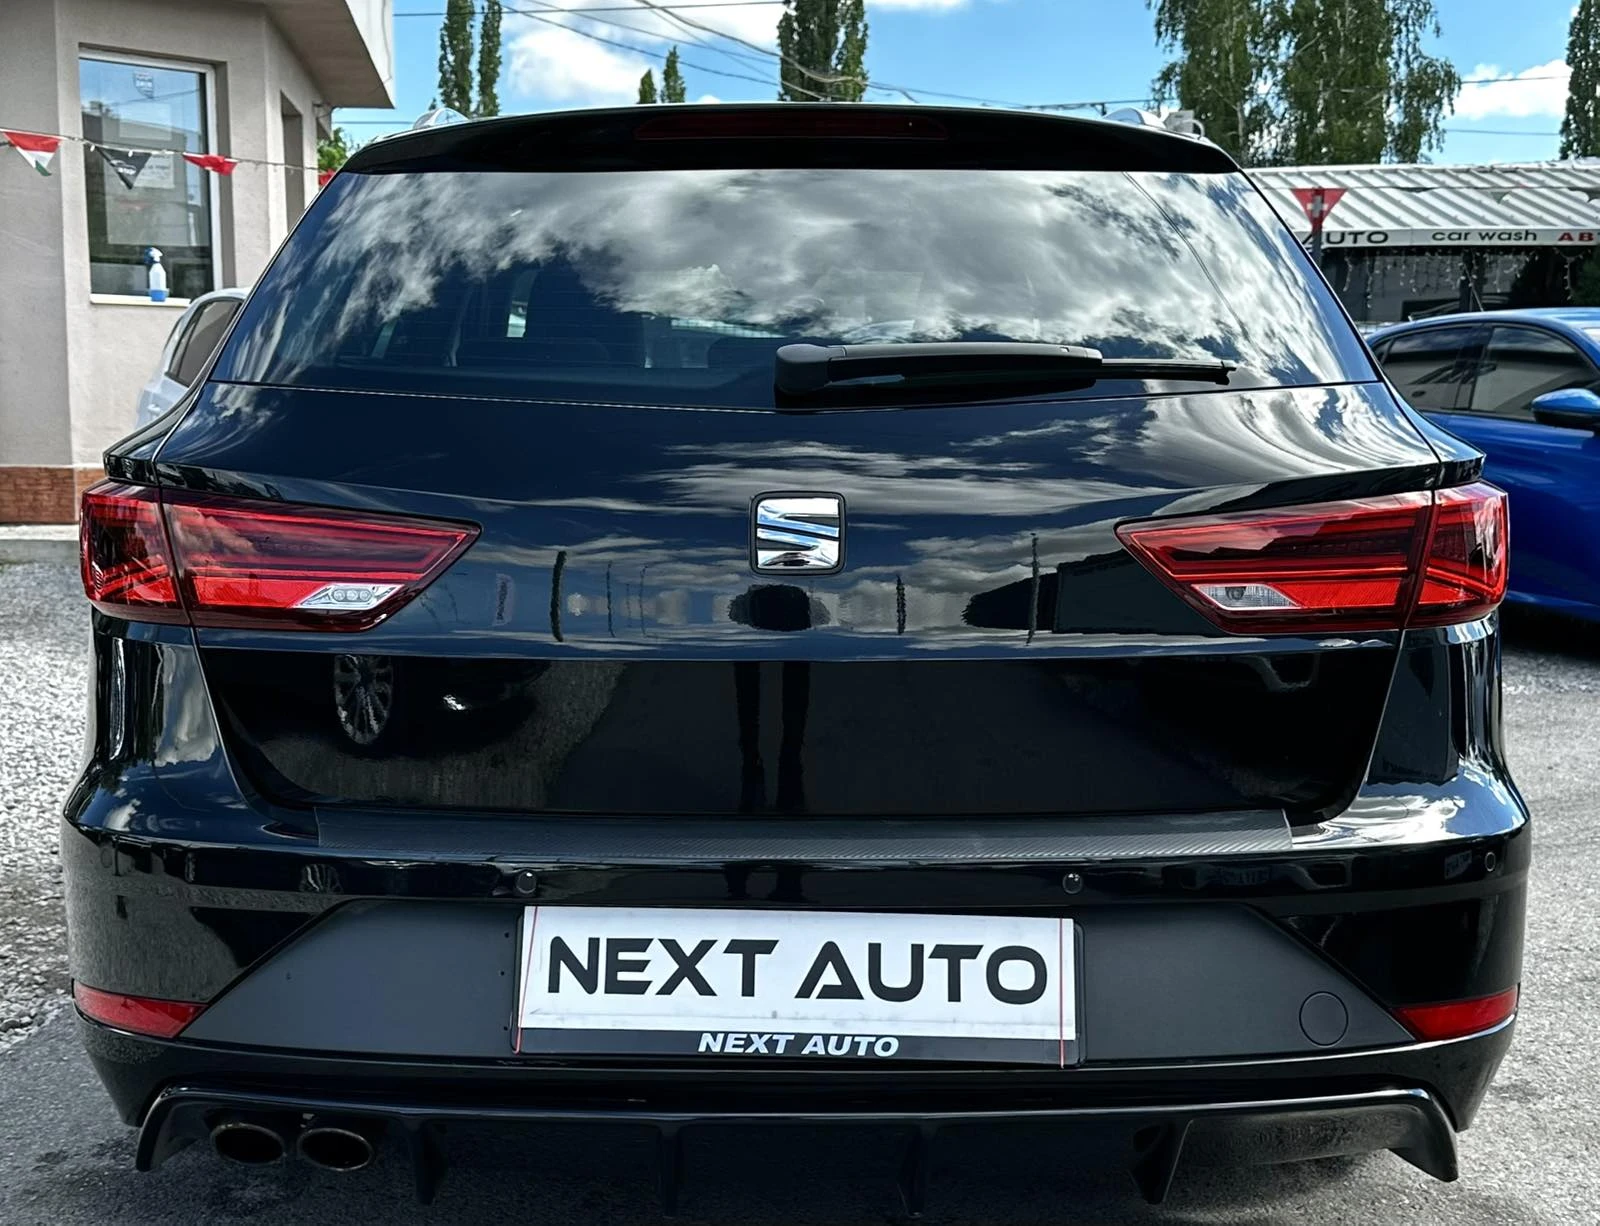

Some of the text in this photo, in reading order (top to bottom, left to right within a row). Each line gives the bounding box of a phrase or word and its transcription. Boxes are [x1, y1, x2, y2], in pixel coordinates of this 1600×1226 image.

[1432, 230, 1537, 241] car wash
[548, 936, 1048, 1004] NEXT AUTO
[698, 1033, 899, 1057] NEXT AUTO
